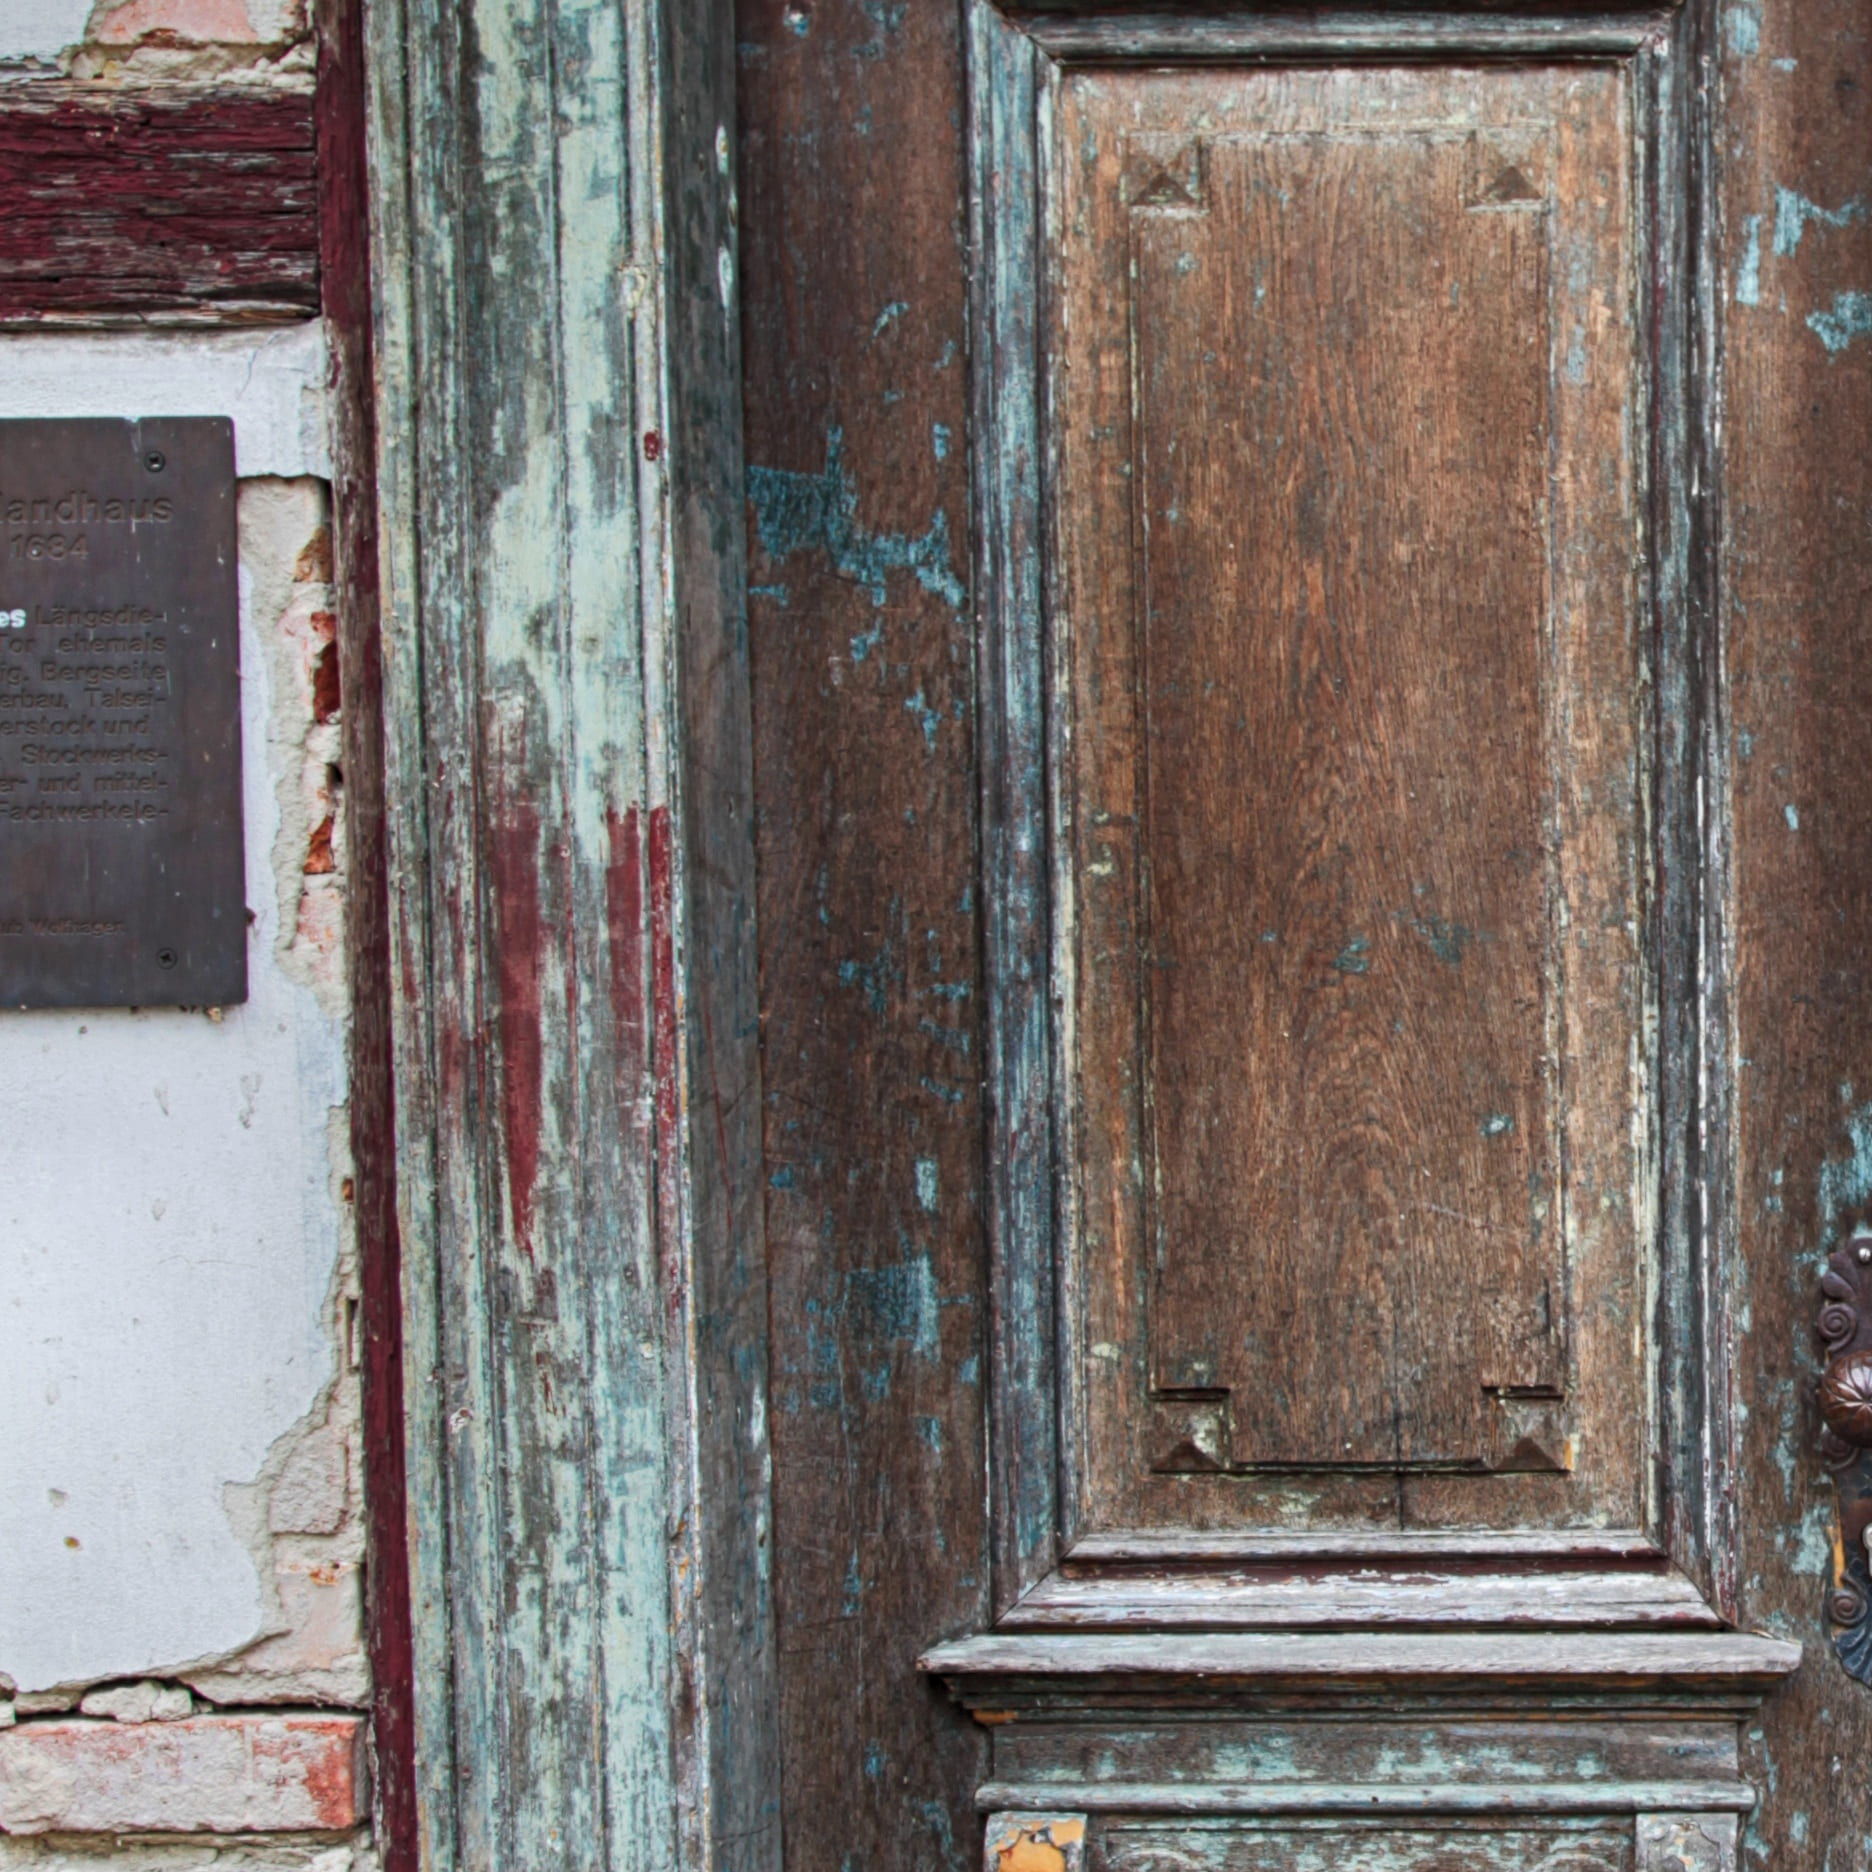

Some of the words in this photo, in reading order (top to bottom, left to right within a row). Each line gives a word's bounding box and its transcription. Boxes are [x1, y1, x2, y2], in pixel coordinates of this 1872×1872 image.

[9, 533, 89, 561] 1684
[58, 632, 168, 654] ehemals
[40, 660, 168, 686] Bergseite
[83, 687, 168, 709] Talsei-
[0, 714, 97, 736] erstock
[103, 714, 151, 736] und
[20, 743, 169, 767] Stockwerks-
[38, 771, 82, 795] und
[94, 771, 169, 795] mittel-
